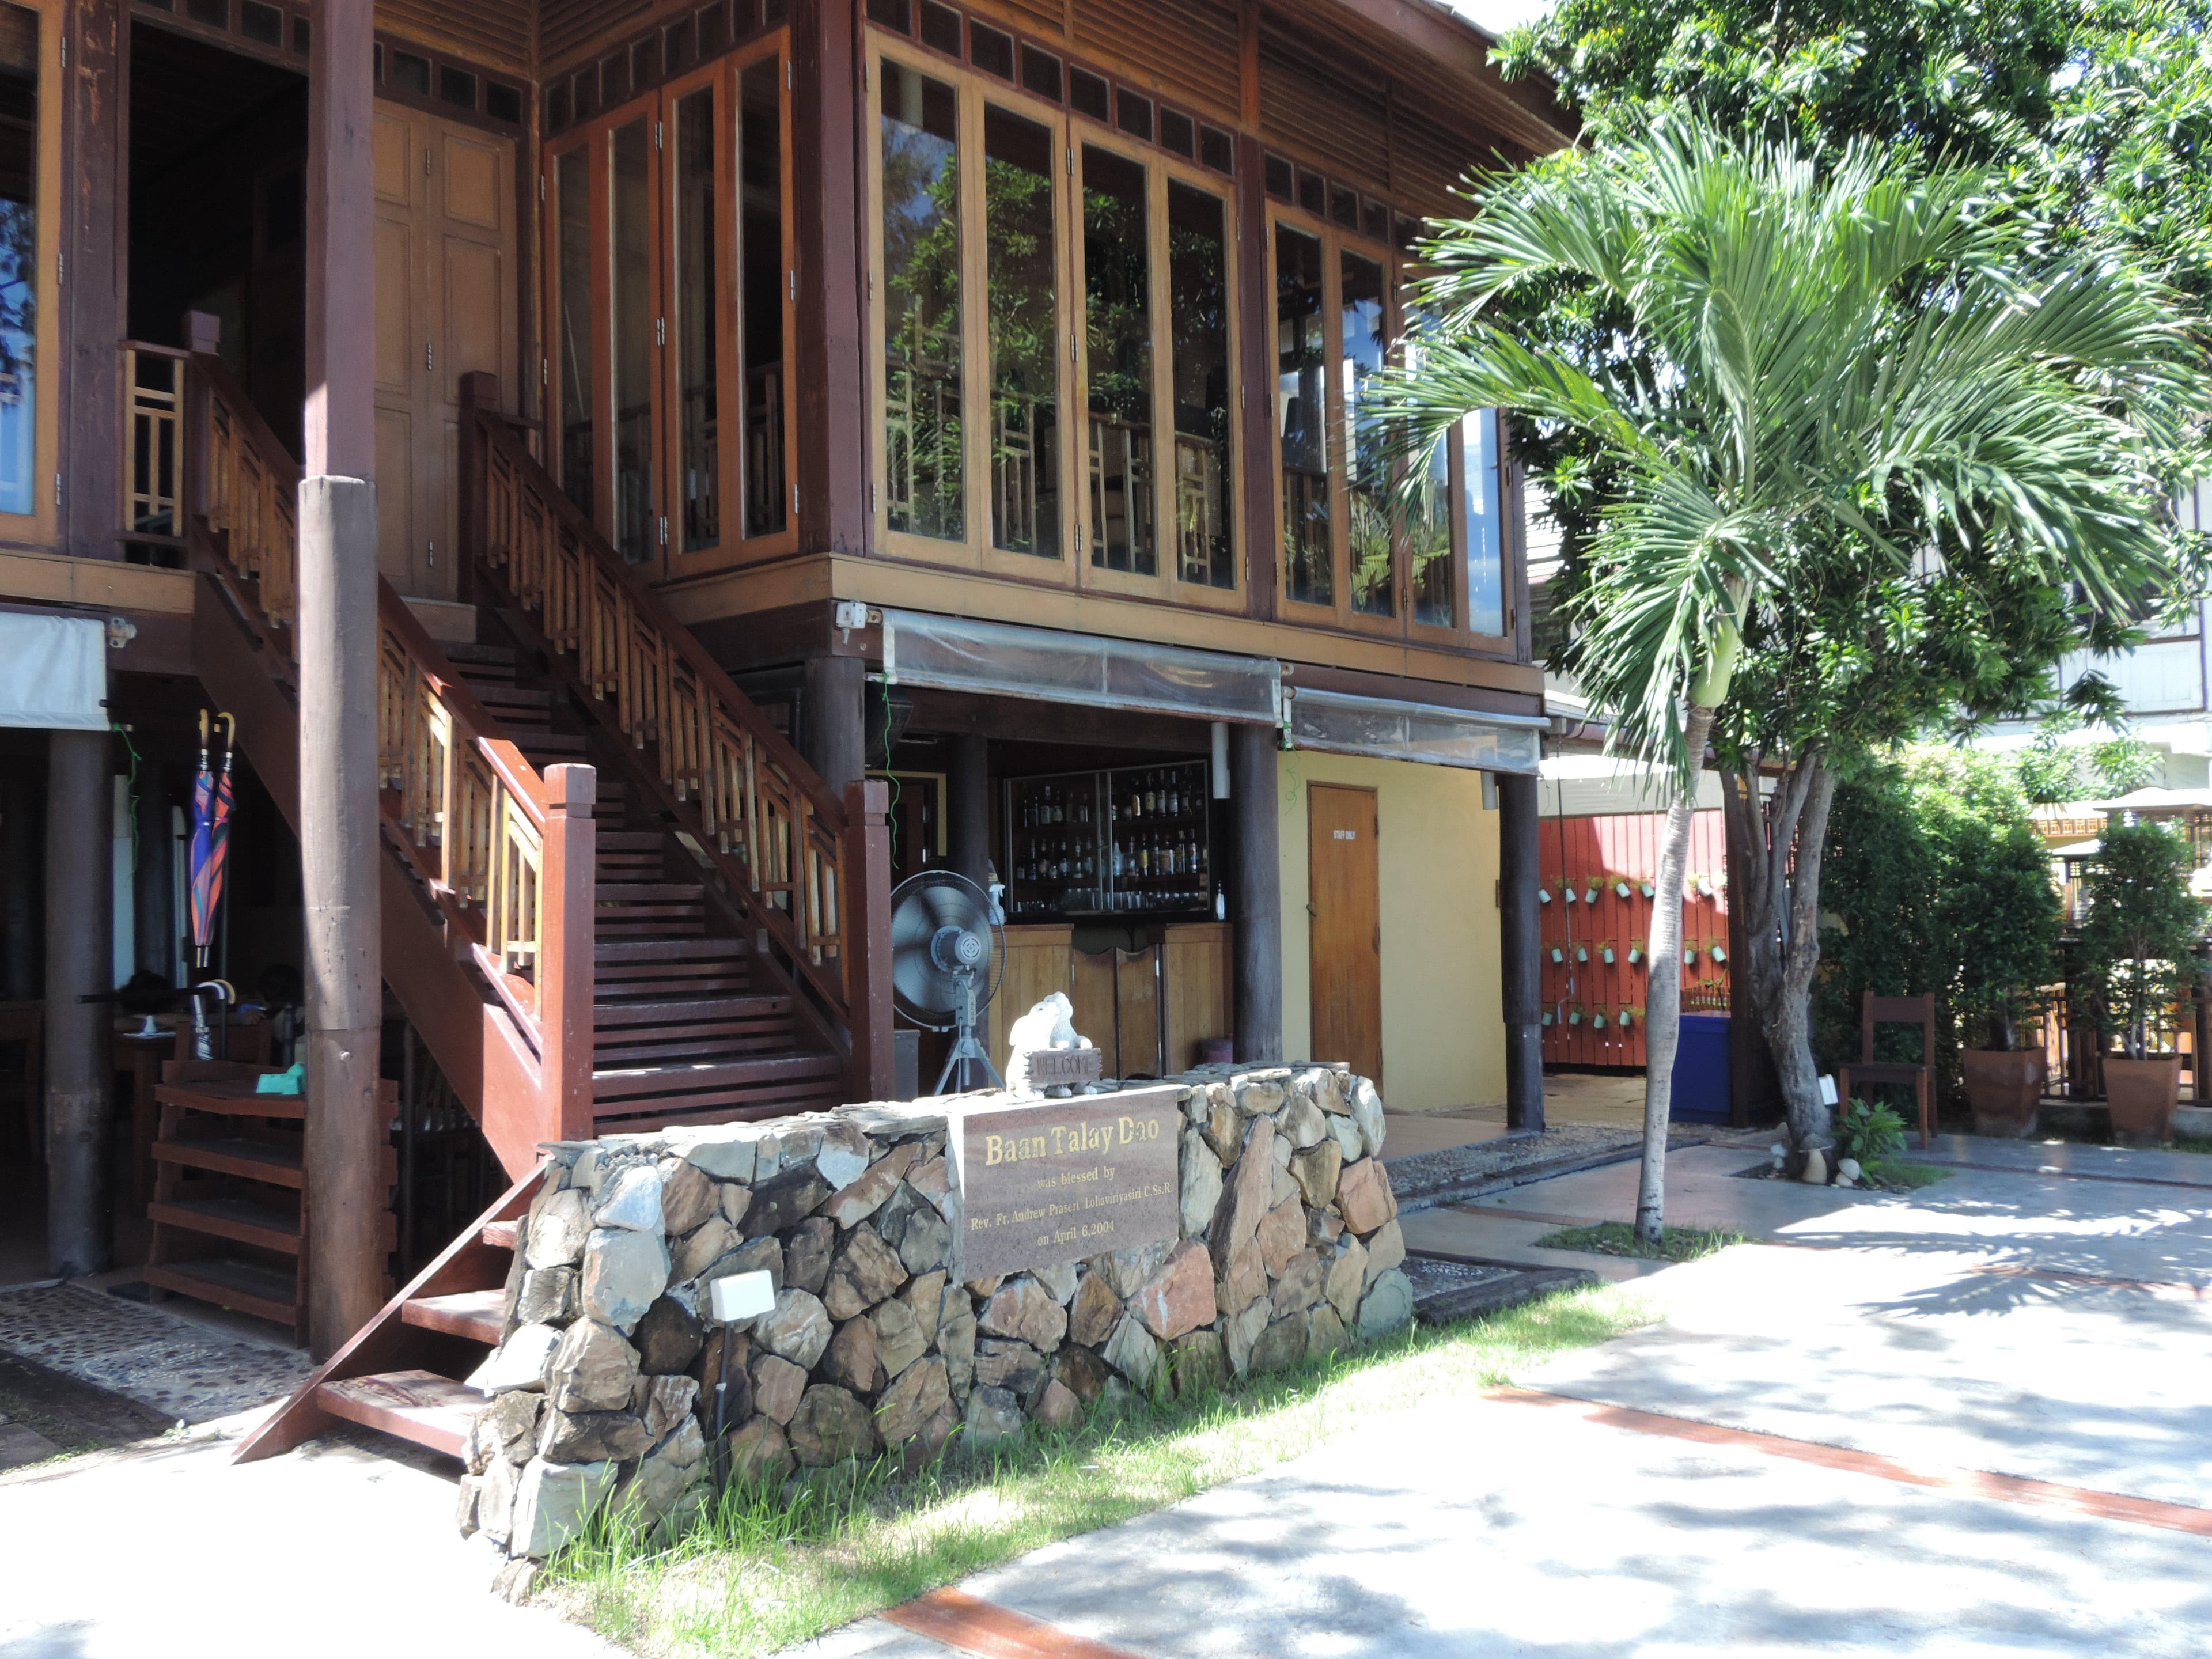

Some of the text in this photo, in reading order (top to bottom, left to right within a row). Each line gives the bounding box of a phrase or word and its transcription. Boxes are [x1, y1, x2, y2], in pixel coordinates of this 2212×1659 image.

[1037, 1054, 1093, 1075] WELCOME
[986, 1116, 1160, 1166] Baan Talay Dao
[1037, 1165, 1116, 1189] was blessed by
[971, 1218, 992, 1230] Rev.
[996, 1213, 1010, 1226] Fr.
[1012, 1208, 1046, 1222] Andrew
[1037, 1236, 1049, 1246] on
[1054, 1227, 1076, 1244] April
